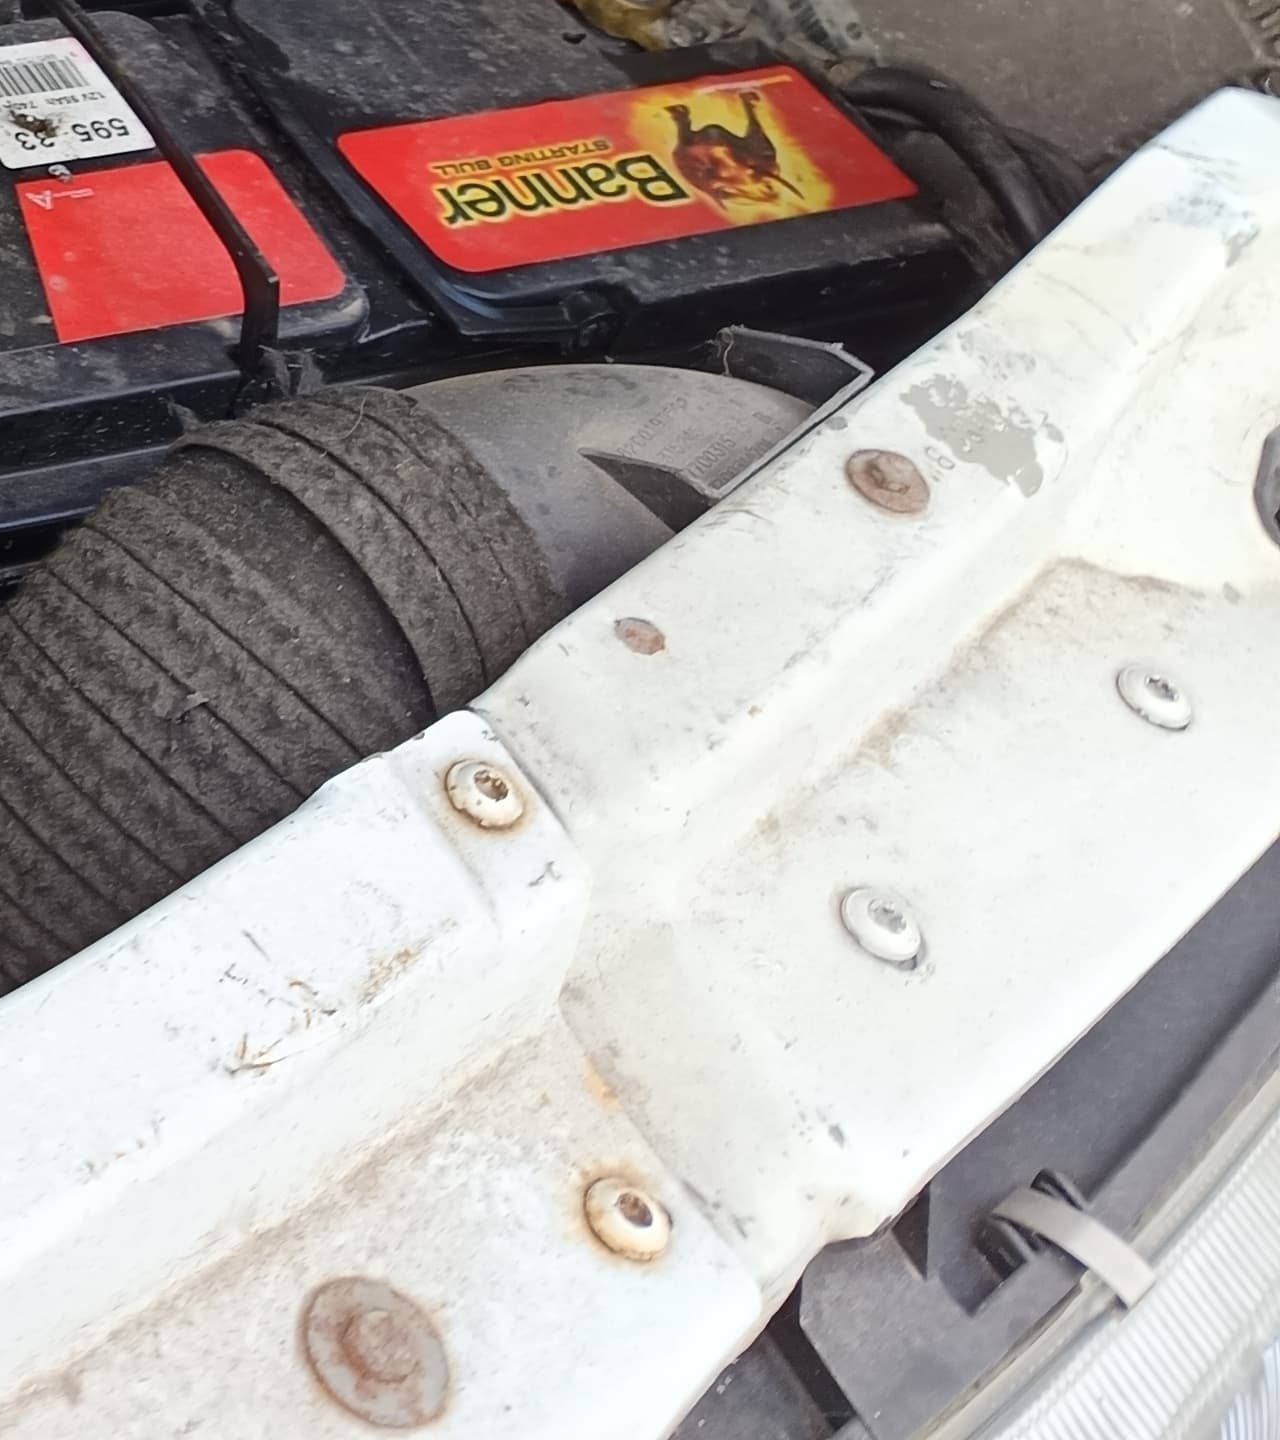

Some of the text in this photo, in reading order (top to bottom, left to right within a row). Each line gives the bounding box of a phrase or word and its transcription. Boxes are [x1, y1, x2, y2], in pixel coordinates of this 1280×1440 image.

[433, 139, 610, 176] STARTING BULL
[435, 153, 691, 226] Banner
